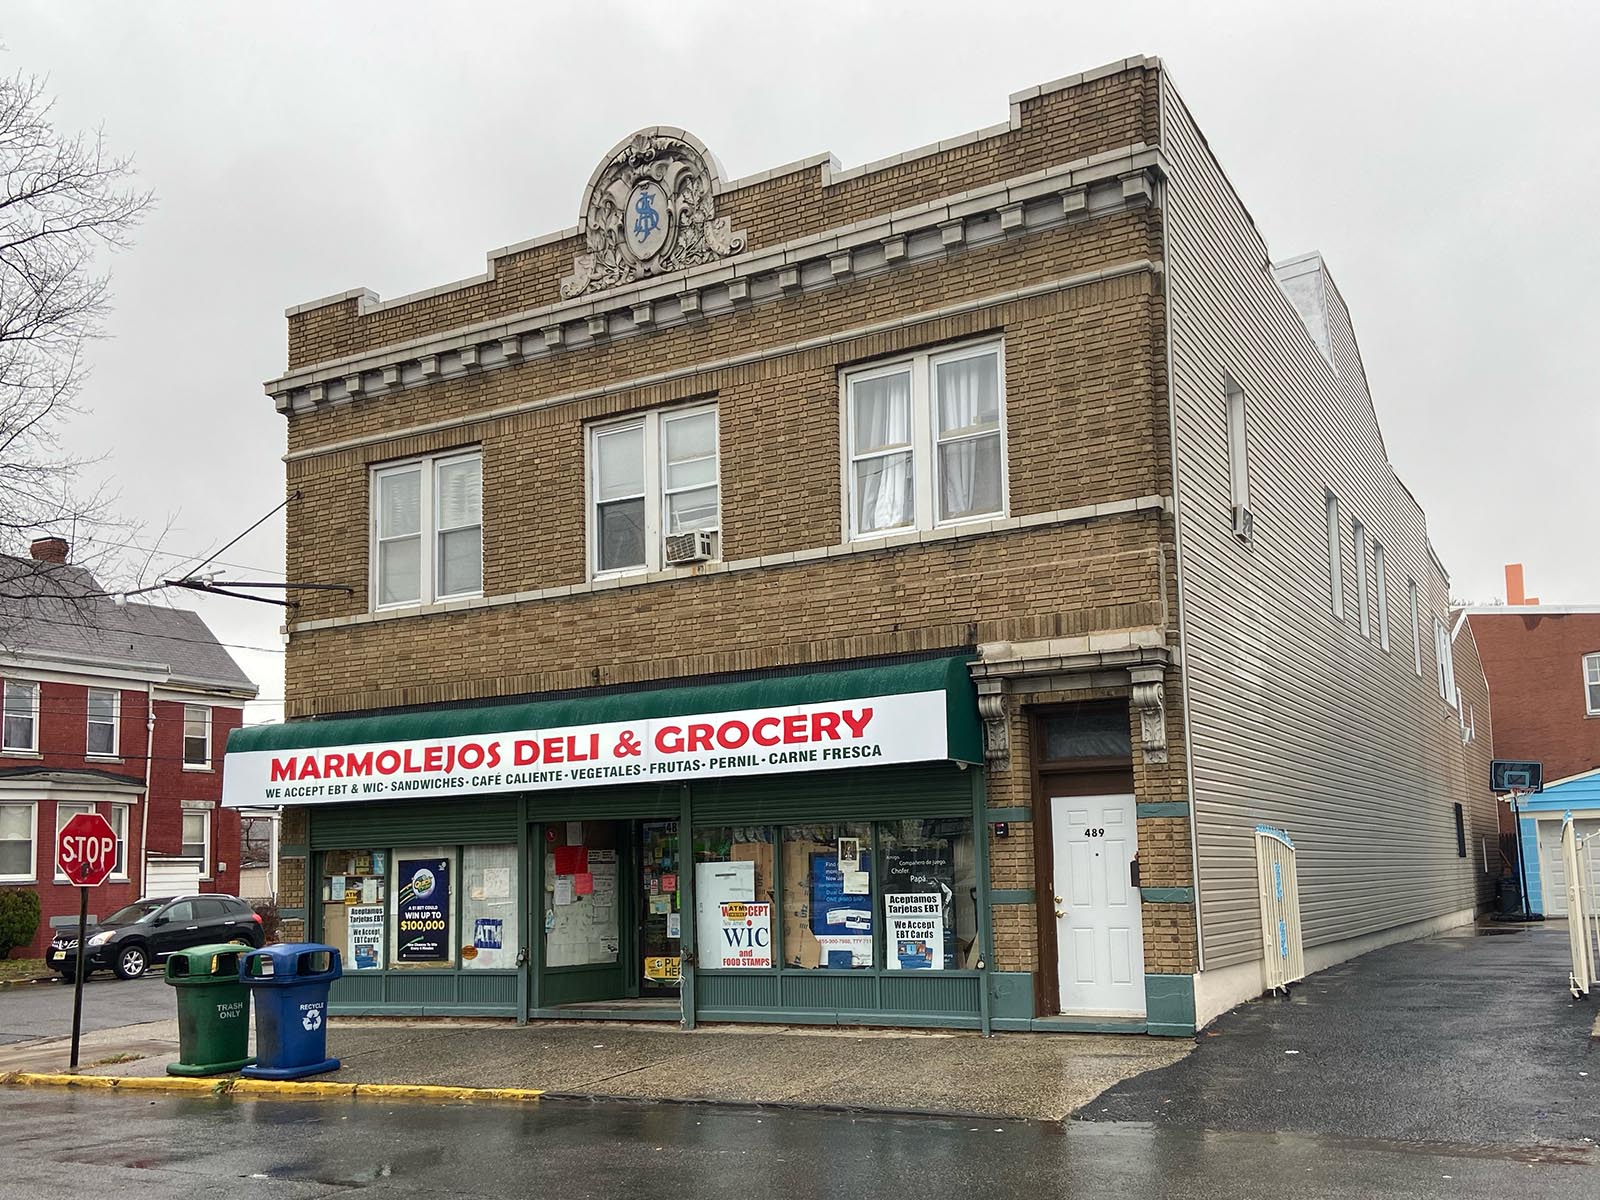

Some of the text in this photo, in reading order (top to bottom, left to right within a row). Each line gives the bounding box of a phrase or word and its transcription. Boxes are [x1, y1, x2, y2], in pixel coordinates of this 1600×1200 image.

[270, 707, 873, 782] MARMOLEJOS DELI & GROCERY
[265, 788, 281, 799] WE
[284, 785, 325, 798] ACCEPT
[328, 783, 347, 795] EBT
[351, 782, 359, 794] &
[363, 781, 384, 793] WIC
[472, 772, 502, 787] CAFÉ
[505, 770, 562, 785] CALIENTE
[768, 749, 818, 765] CARNE
[823, 744, 882, 760] FRESCA
[1084, 828, 1105, 838] 489
[62, 835, 113, 863] STOP
[889, 895, 937, 904] Aceptamos
[351, 908, 383, 916] Aceptamos
[888, 904, 939, 914] Tarjetas EBT
[350, 915, 373, 923] Tarjetas
[405, 911, 442, 919] WIN UP TO
[401, 920, 445, 932] $100,000
[894, 920, 935, 929] We Accept
[362, 928, 381, 936] Accept
[475, 924, 502, 943] ATM
[896, 930, 910, 939] EBT
[910, 930, 934, 939] Cards
[722, 927, 769, 948] WIC
[739, 949, 753, 957] and
[723, 957, 770, 967] FOOD STAMPS
[217, 1002, 243, 1012] TRASH
[300, 1002, 324, 1010] RECYCLE
[220, 1010, 241, 1019] ONLY
